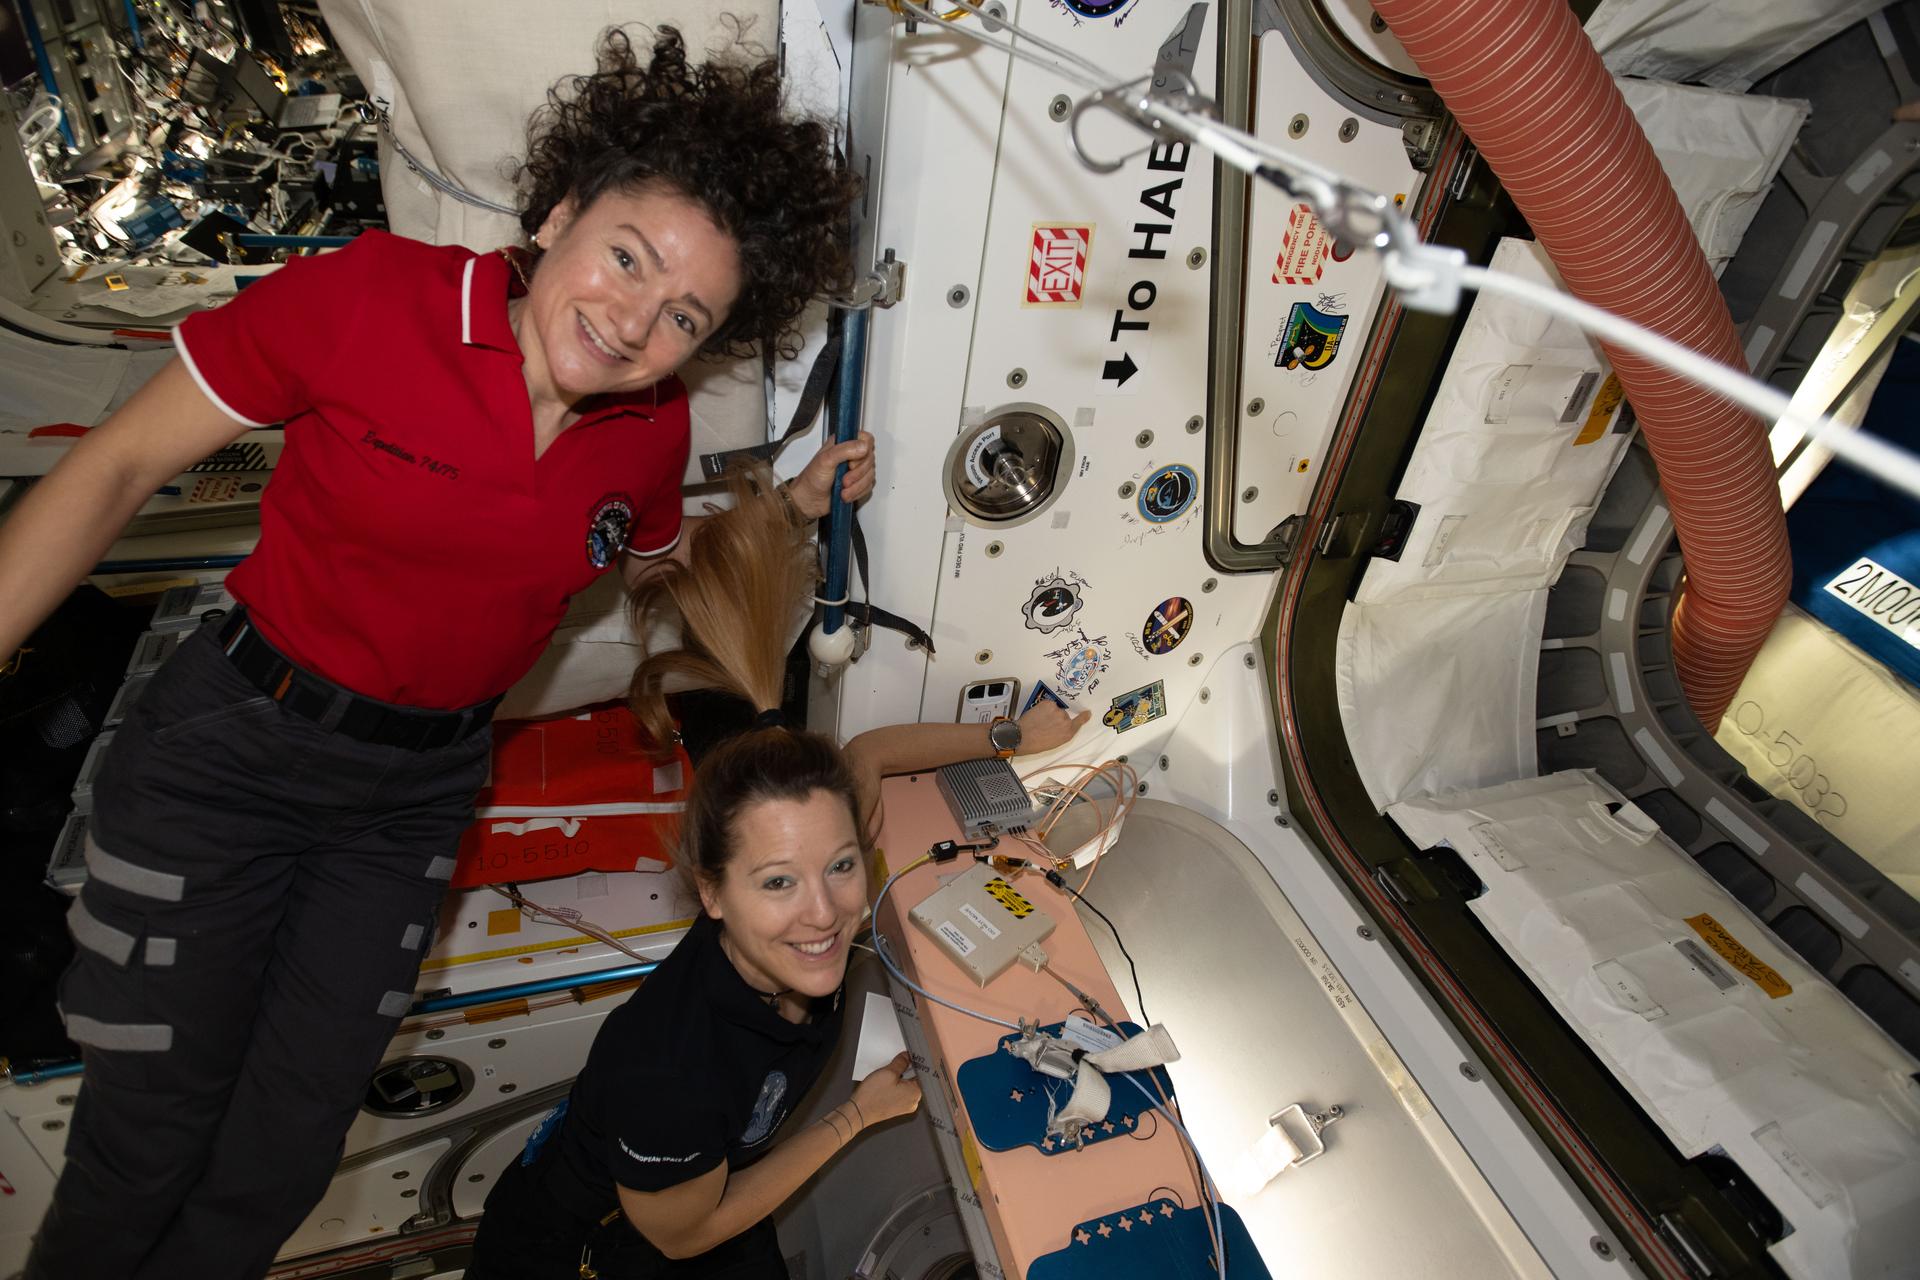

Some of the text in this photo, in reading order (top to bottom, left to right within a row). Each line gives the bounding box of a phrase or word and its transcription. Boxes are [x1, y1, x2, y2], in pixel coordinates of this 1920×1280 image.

[1128, 138, 1192, 261] HAB
[1042, 241, 1077, 291] EXIT
[1282, 214, 1305, 275] EMERGENCY USE
[1293, 215, 1319, 275] FIRE PORT
[361, 430, 460, 481] Expedition 74/75
[969, 431, 995, 484] Vacuum Access Port
[955, 554, 963, 568] DECK
[1833, 562, 1920, 633] 2M00
[628, 1148, 661, 1163] EUROPEAN
